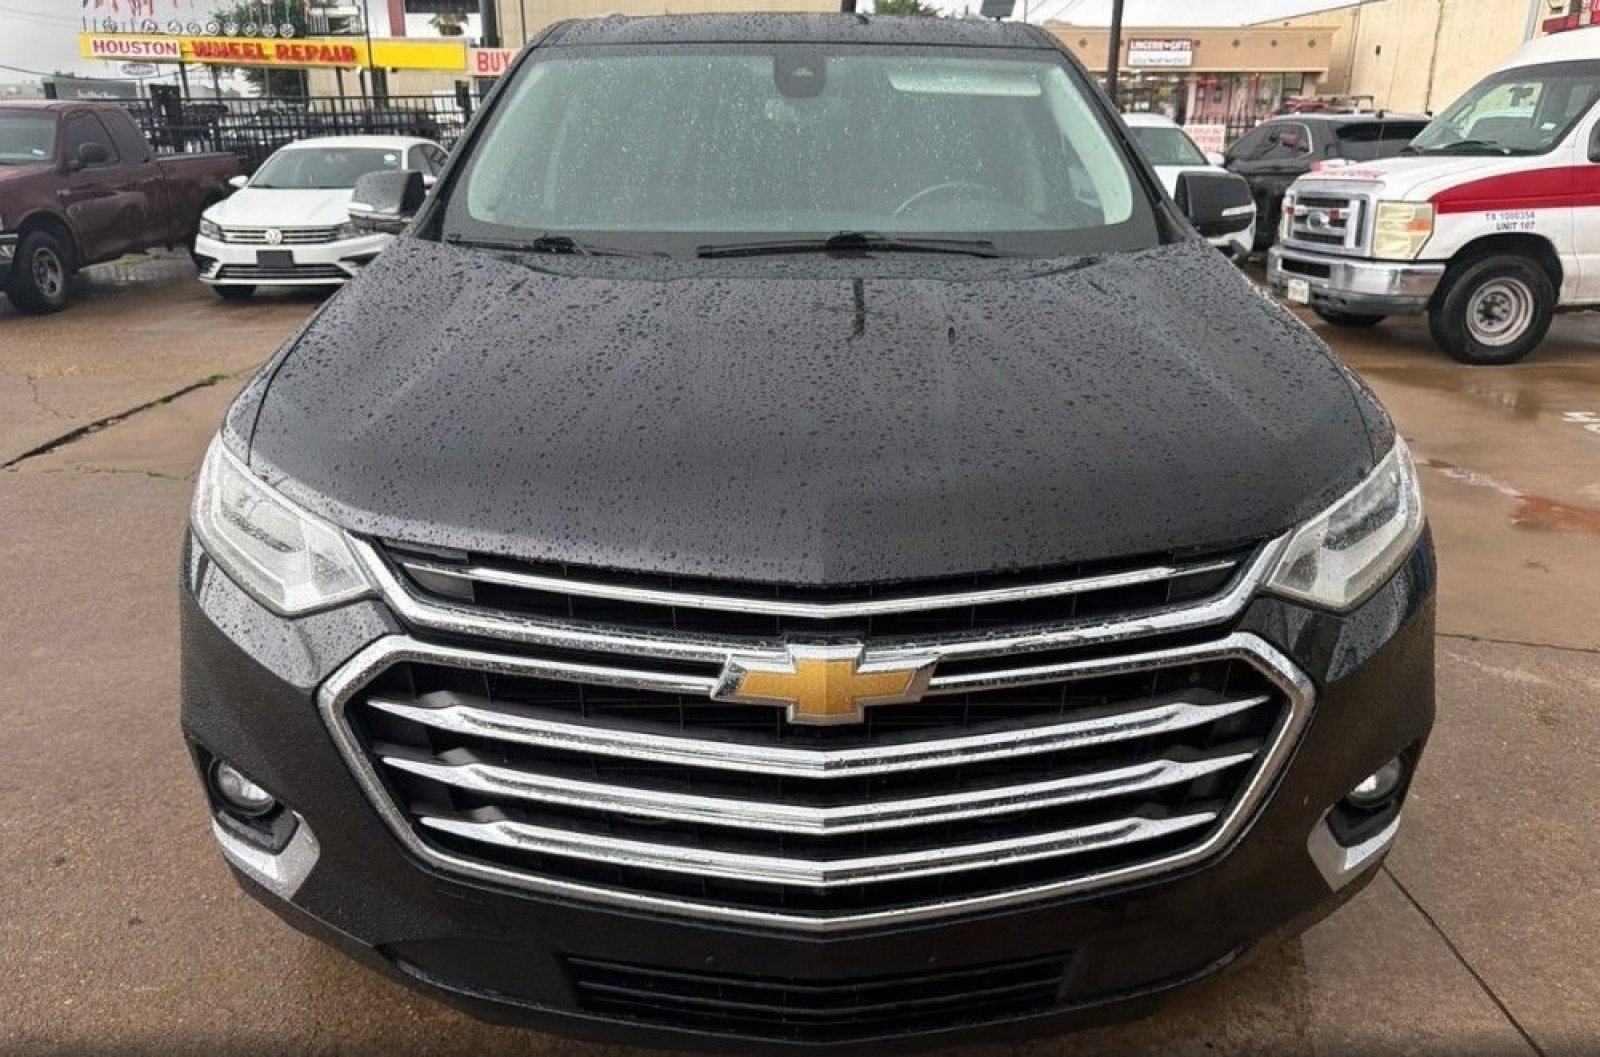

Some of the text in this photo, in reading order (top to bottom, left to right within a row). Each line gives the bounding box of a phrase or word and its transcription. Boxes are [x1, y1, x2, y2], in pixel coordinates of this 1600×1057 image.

[92, 39, 357, 63] HOUSTON WHEEL REPAIR
[477, 50, 511, 72] BUY
[1496, 221, 1517, 231] UNIT
